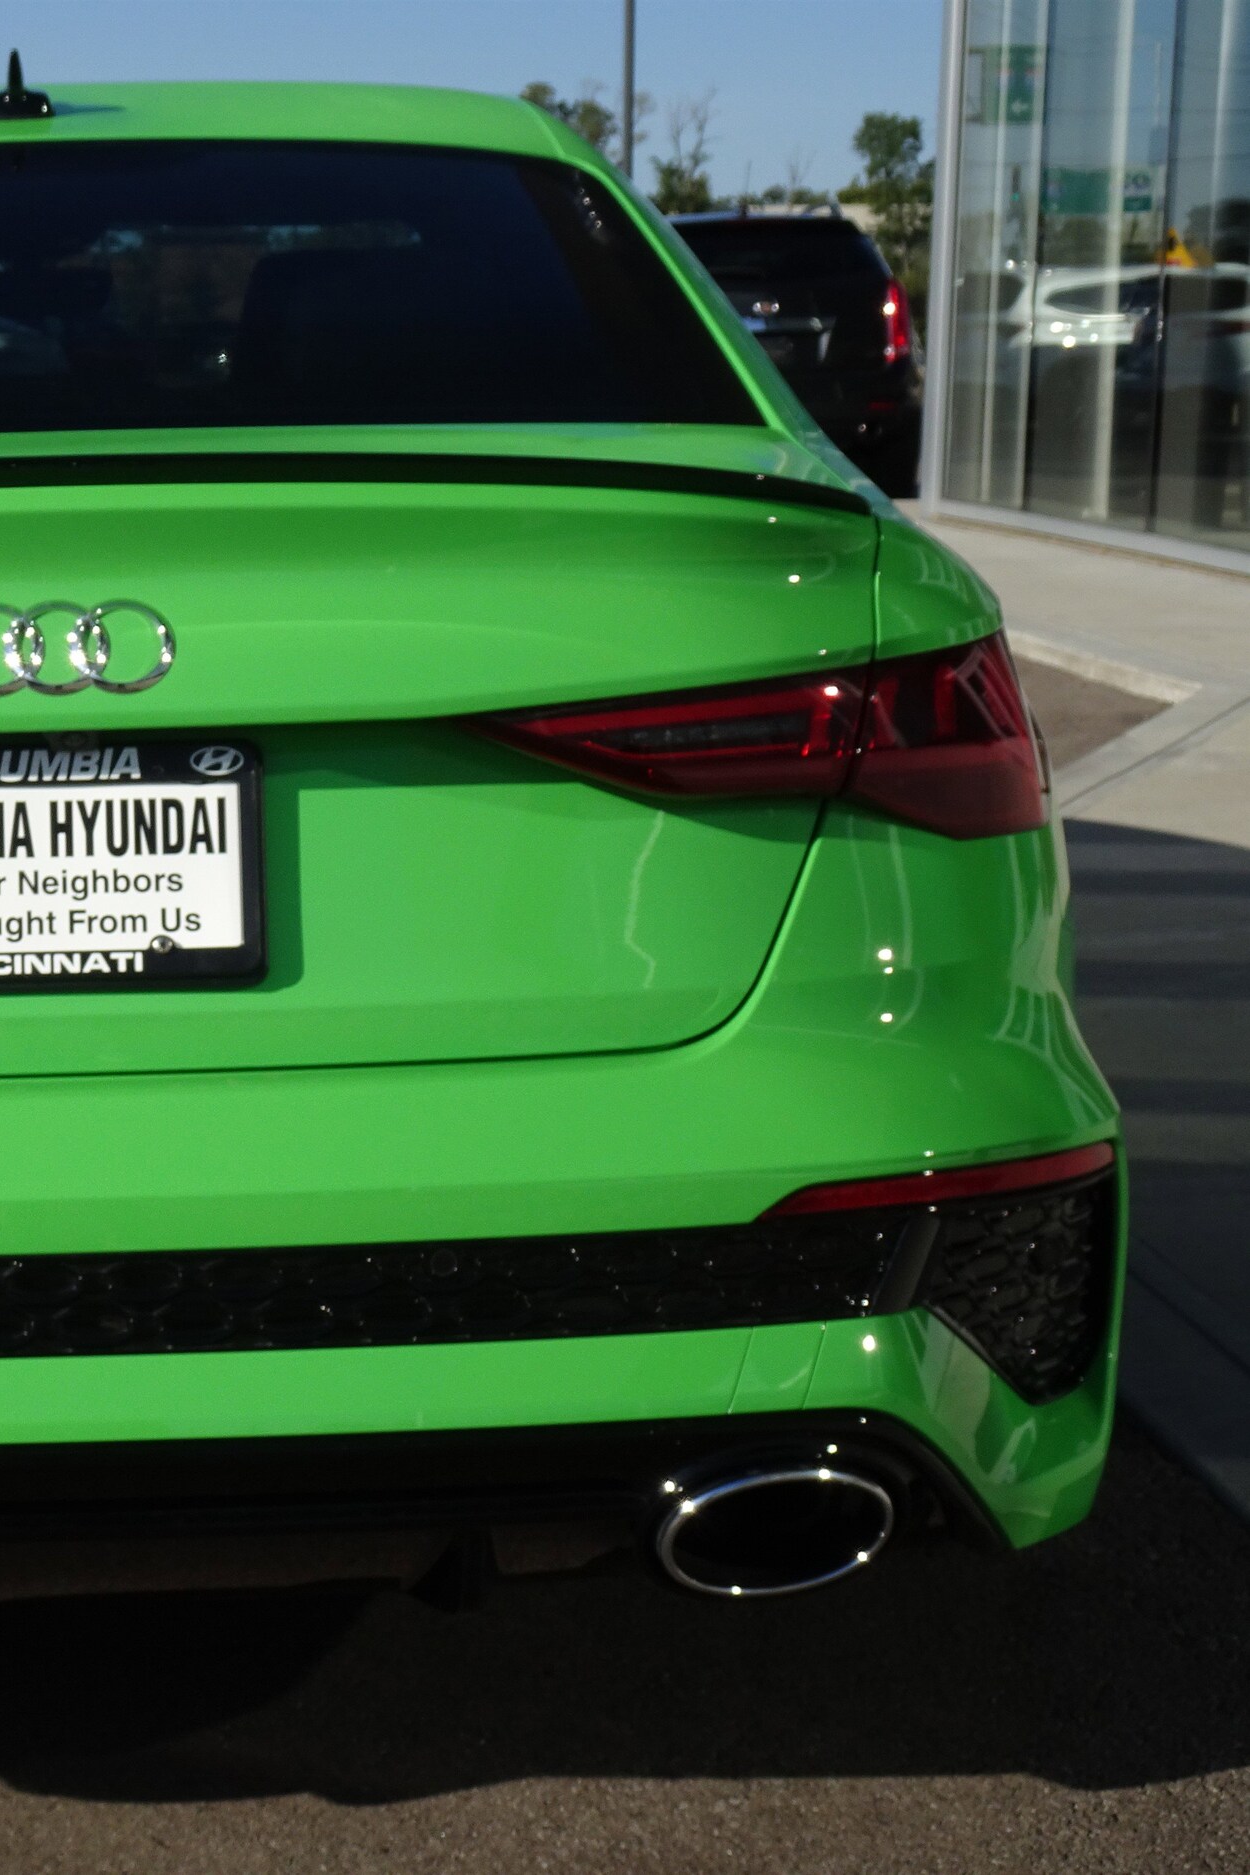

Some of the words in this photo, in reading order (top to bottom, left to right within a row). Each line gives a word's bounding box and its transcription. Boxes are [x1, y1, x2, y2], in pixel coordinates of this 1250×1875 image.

[49, 797, 228, 858] HYUNDAI
[18, 868, 184, 901] Neighbors
[68, 908, 148, 935] From
[161, 907, 202, 933] Us
